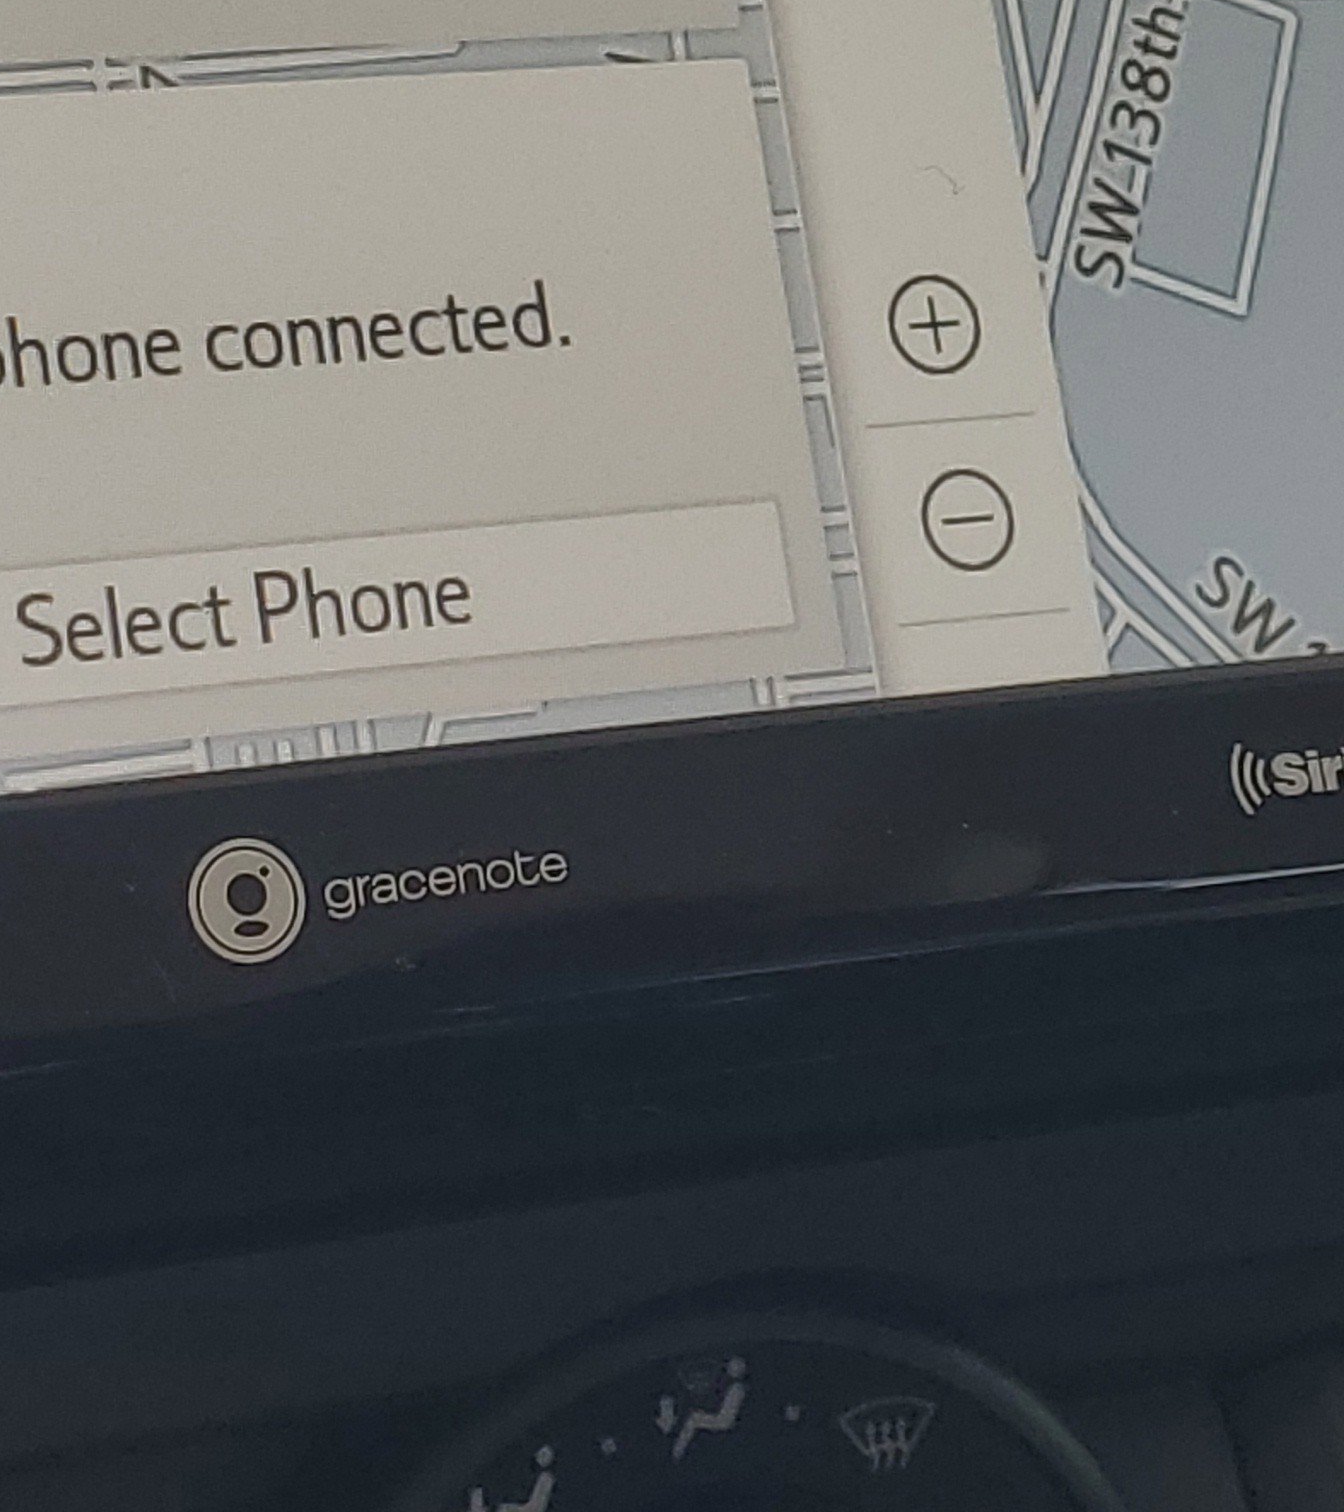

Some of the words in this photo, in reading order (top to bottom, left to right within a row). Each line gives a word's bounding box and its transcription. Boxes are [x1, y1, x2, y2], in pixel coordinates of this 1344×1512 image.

[1102, 2, 1186, 166] 138th
[1074, 176, 1141, 289] SW
[205, 278, 575, 372] connected.
[15, 584, 238, 670] Select
[254, 567, 474, 646] Phone
[1195, 555, 1296, 655] SW
[322, 848, 570, 920] gracenote
